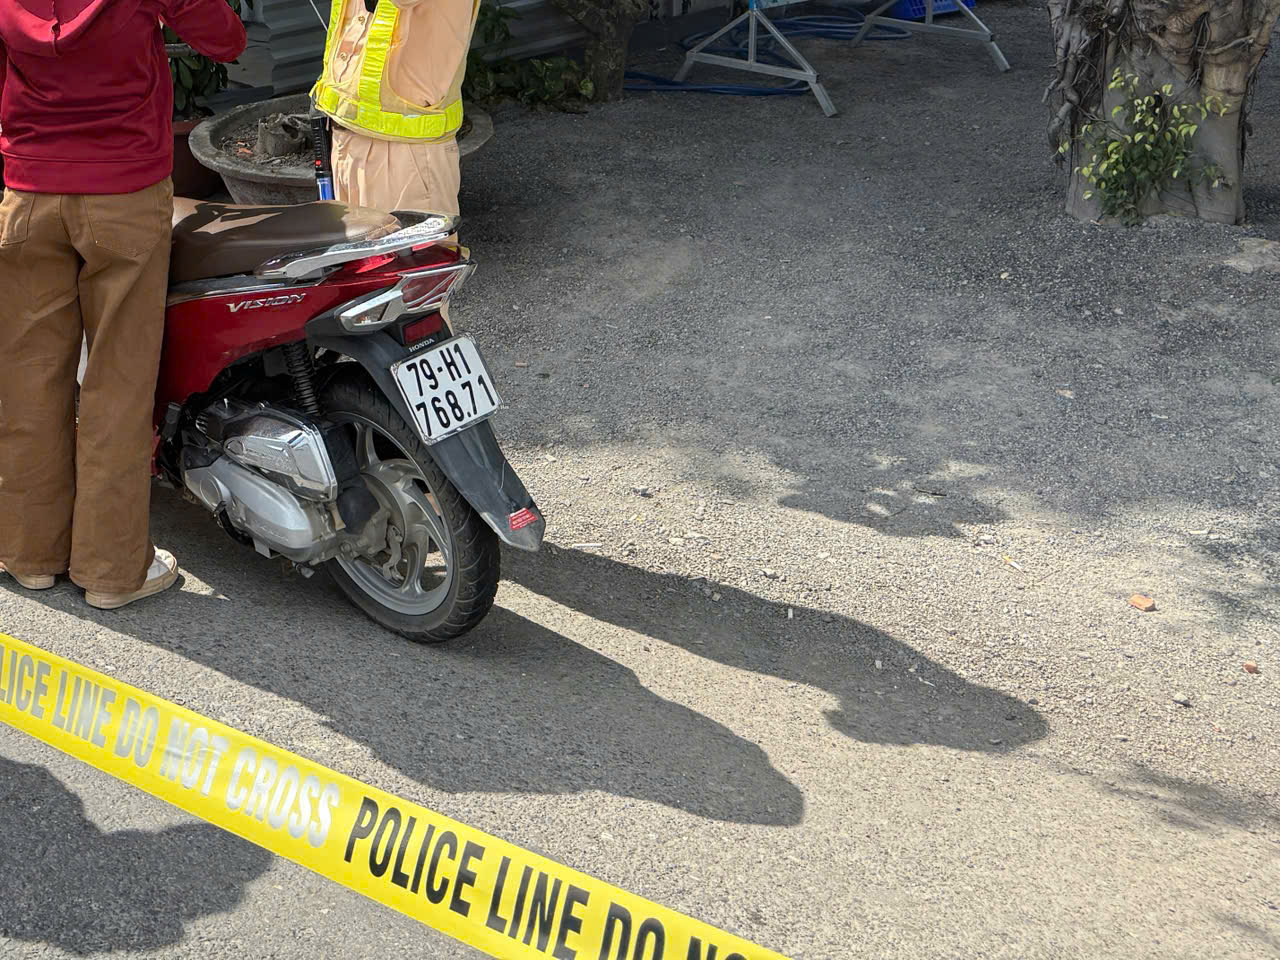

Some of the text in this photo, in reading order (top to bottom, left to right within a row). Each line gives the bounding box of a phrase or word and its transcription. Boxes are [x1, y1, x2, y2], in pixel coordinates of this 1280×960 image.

[226, 292, 306, 312] VISION
[406, 343, 471, 397] 79-H1
[408, 338, 435, 352] HONDA
[415, 374, 495, 437] 768.71
[51, 671, 117, 748] LINE
[114, 697, 159, 768] DO
[160, 717, 230, 796] NOT
[226, 746, 341, 848] CROSS
[343, 796, 665, 960] POLICE LINE DO
